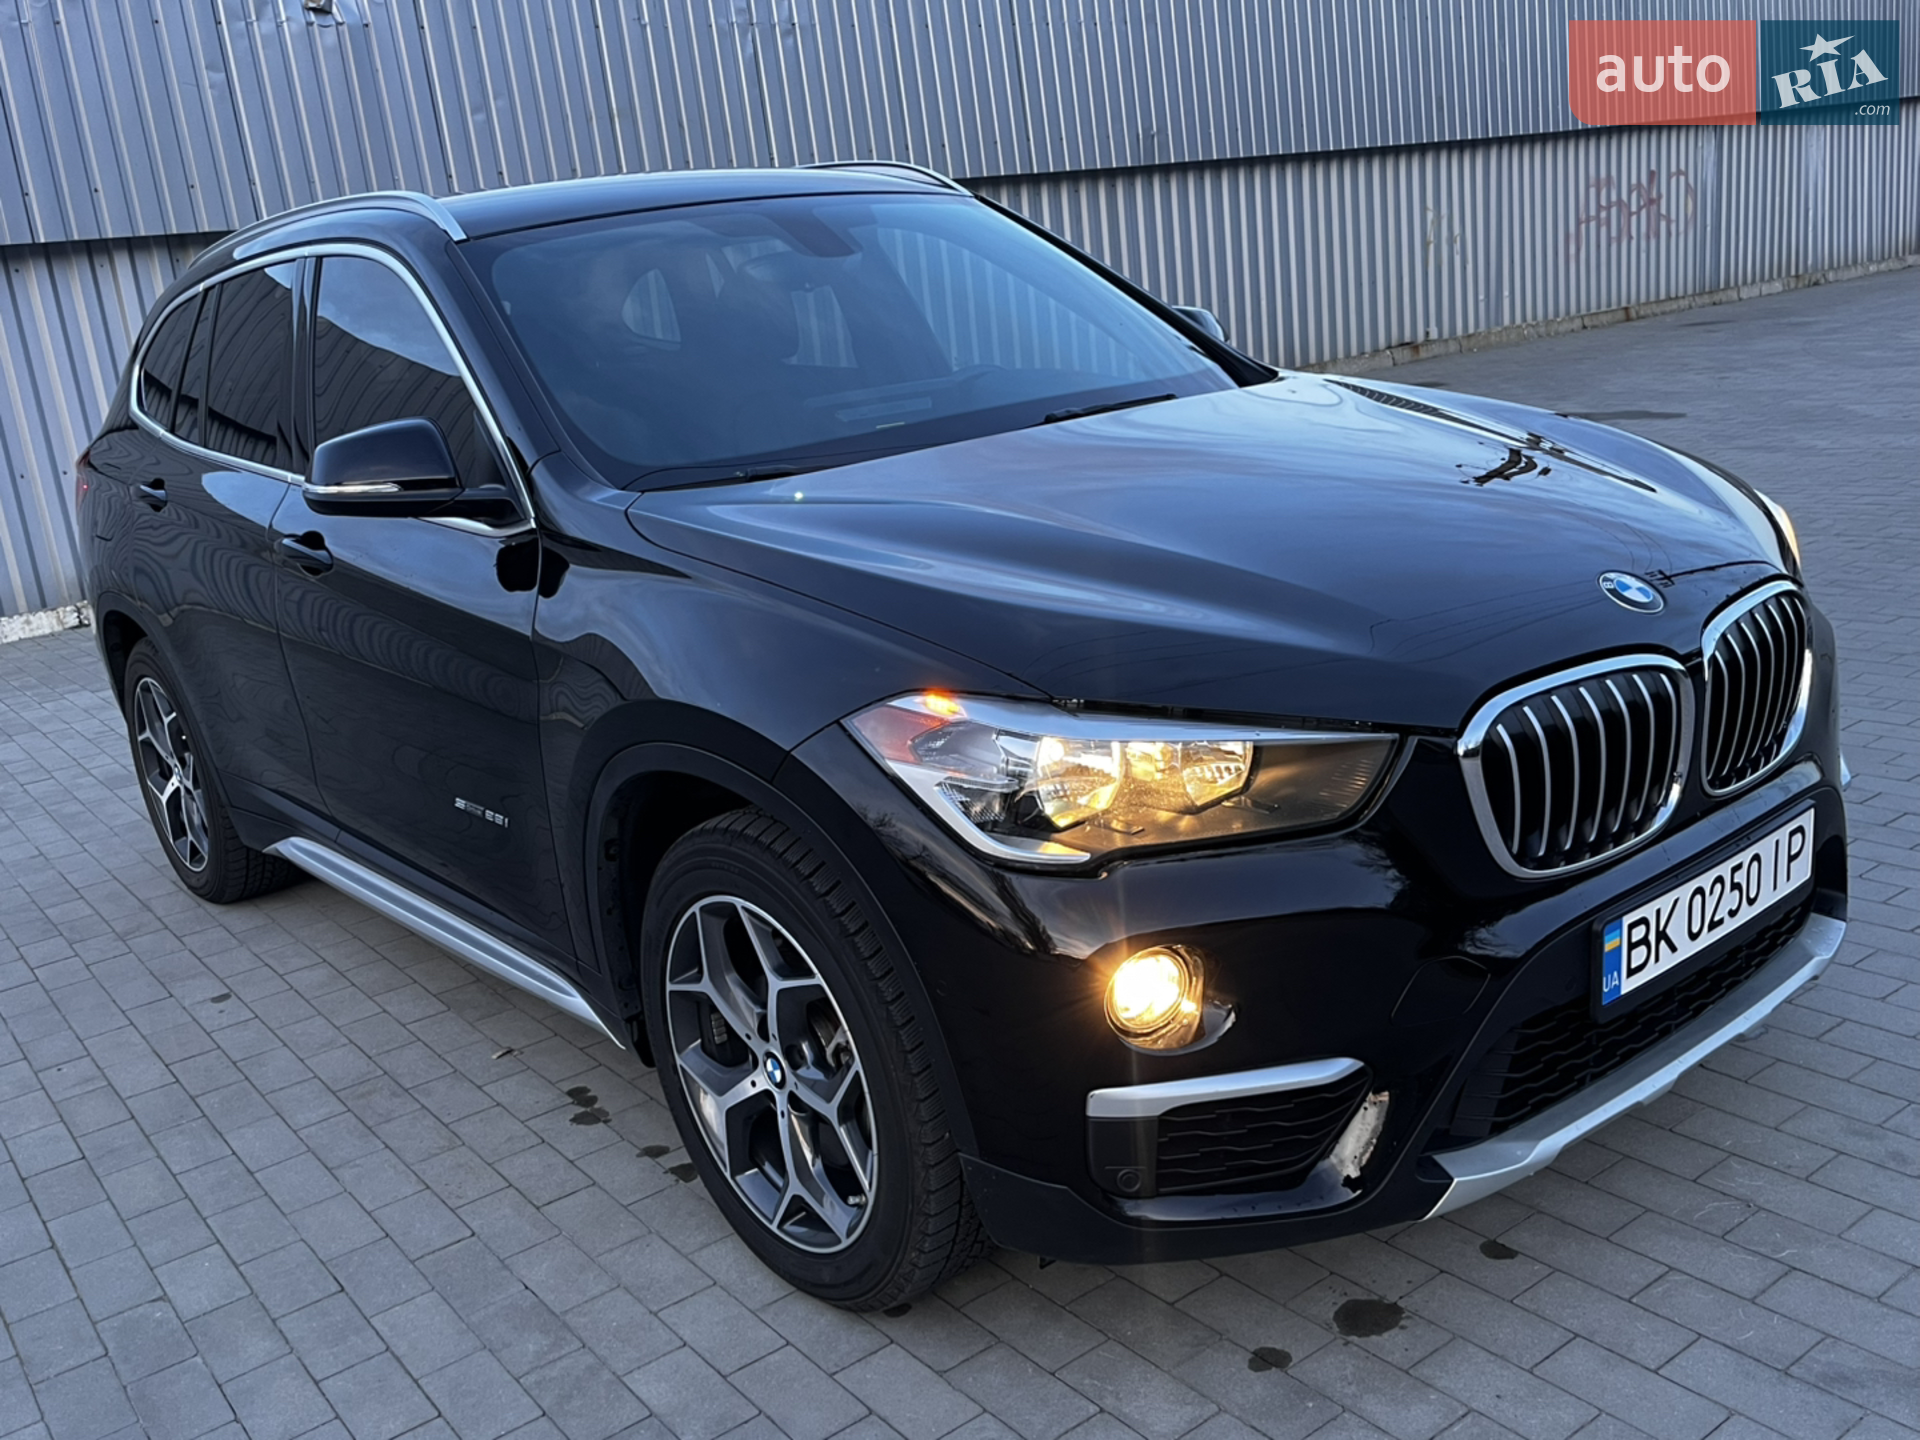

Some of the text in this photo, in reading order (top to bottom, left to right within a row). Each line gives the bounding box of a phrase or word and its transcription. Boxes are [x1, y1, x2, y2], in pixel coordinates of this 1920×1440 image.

[1626, 825, 1806, 979] BK 0250 IP
[1603, 971, 1619, 992] UA
